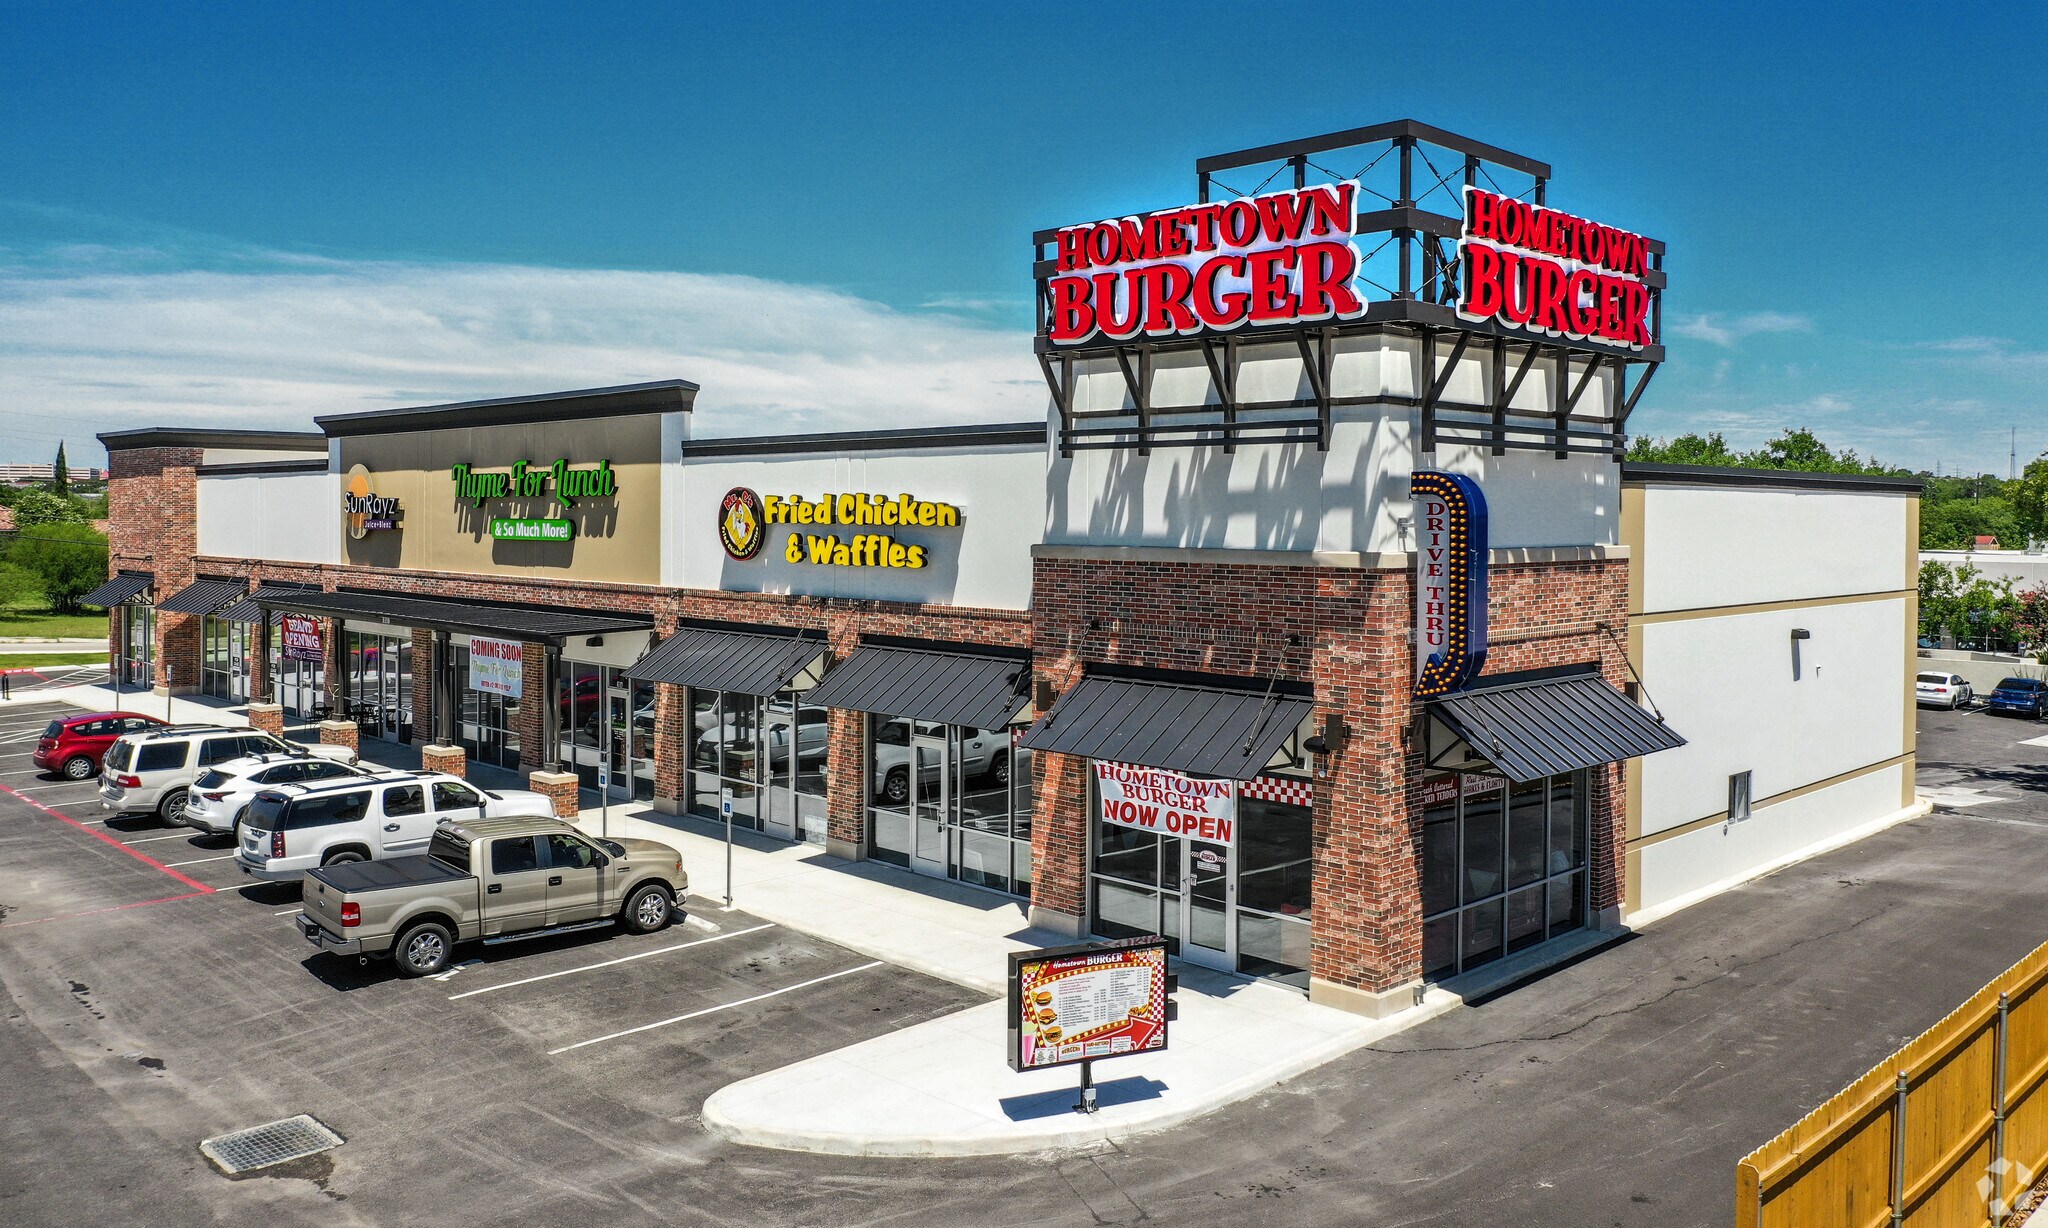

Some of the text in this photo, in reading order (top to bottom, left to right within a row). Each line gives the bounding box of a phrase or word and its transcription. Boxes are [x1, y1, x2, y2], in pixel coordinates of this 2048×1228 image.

[1054, 184, 1356, 271] HOMETOWN
[1468, 189, 1649, 278] HOMETOWN
[1050, 241, 1362, 340] BURGER
[1462, 243, 1652, 346] BURGER
[452, 458, 616, 508] Thyme For Lunch
[344, 491, 396, 519] SunRayz
[764, 493, 958, 526] Fried Chicken
[494, 522, 568, 538] & So Much More!
[785, 532, 925, 568] & Waffles
[1426, 502, 1445, 646] DRIVE THRU
[285, 631, 320, 648] OPENING
[288, 618, 314, 634] GRAND
[471, 639, 522, 662] COMING SOON
[1099, 764, 1230, 799] HOMETOWN
[1122, 783, 1208, 813] BURGER
[1436, 789, 1458, 801] TENDERS
[1104, 799, 1232, 843] NOW OPEN
[1053, 953, 1123, 969] Hometown BURGER
